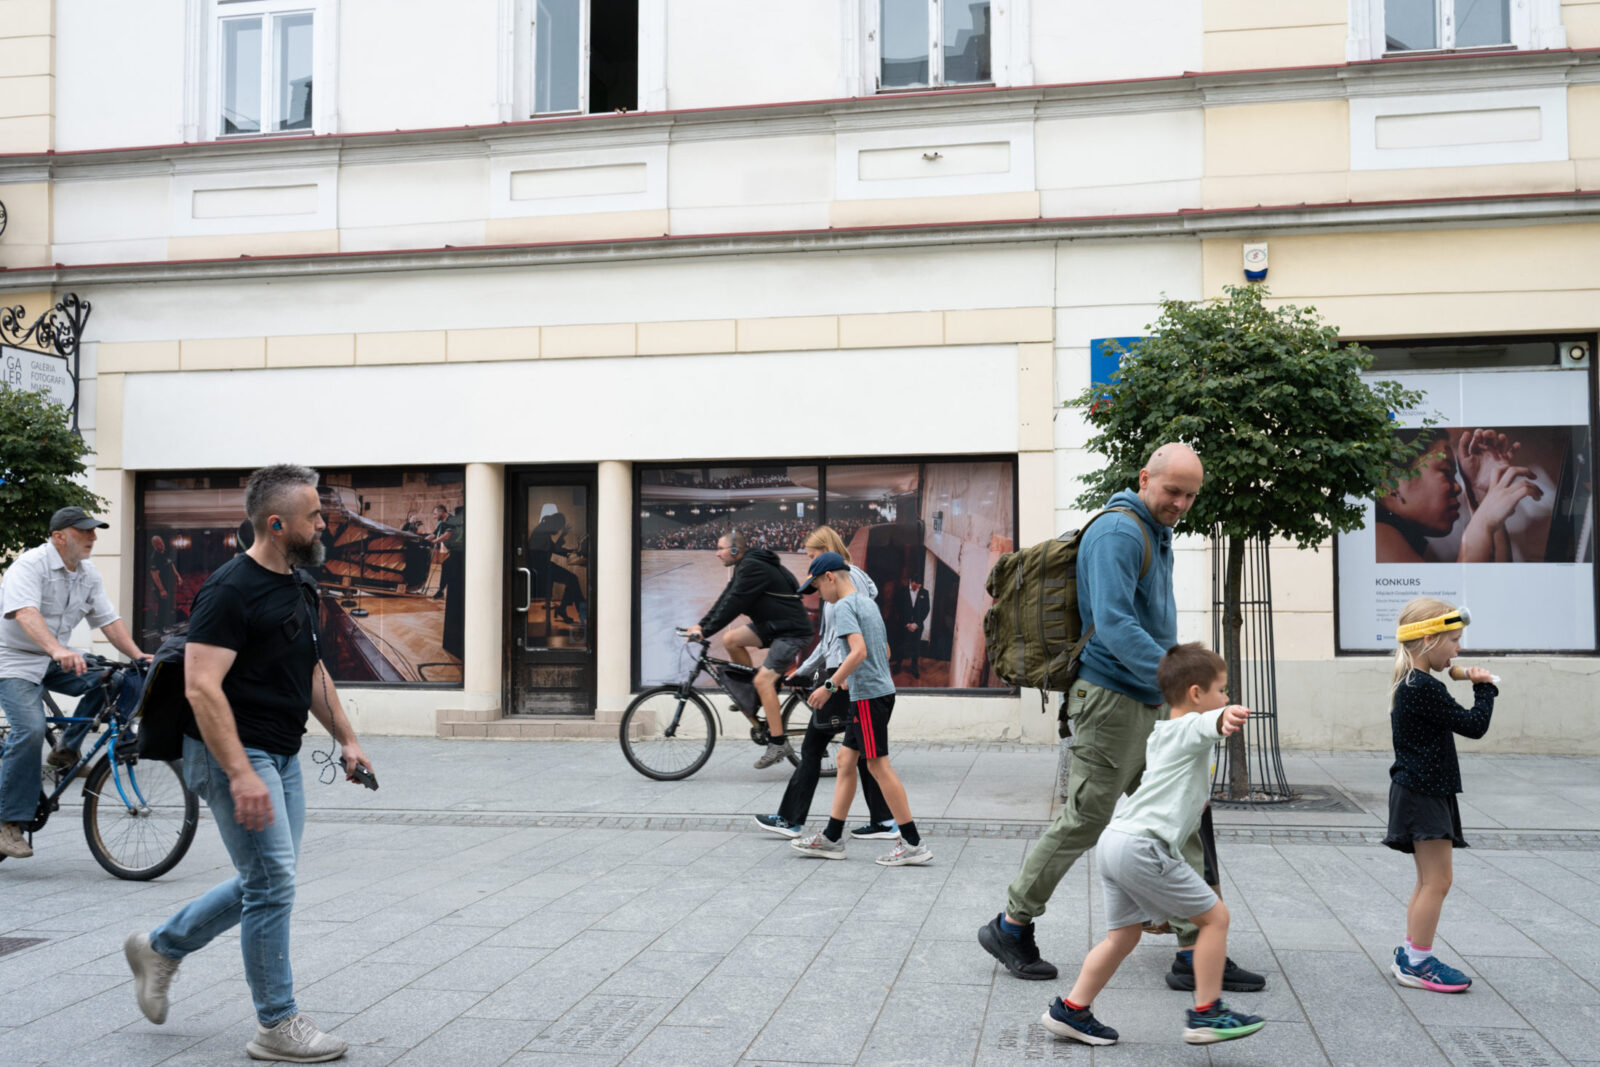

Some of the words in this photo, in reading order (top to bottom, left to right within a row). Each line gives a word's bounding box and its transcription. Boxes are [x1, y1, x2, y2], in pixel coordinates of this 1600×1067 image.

[6, 355, 22, 371] GA
[30, 360, 56, 373] GALERIA
[1375, 577, 1422, 586] KONKURS
